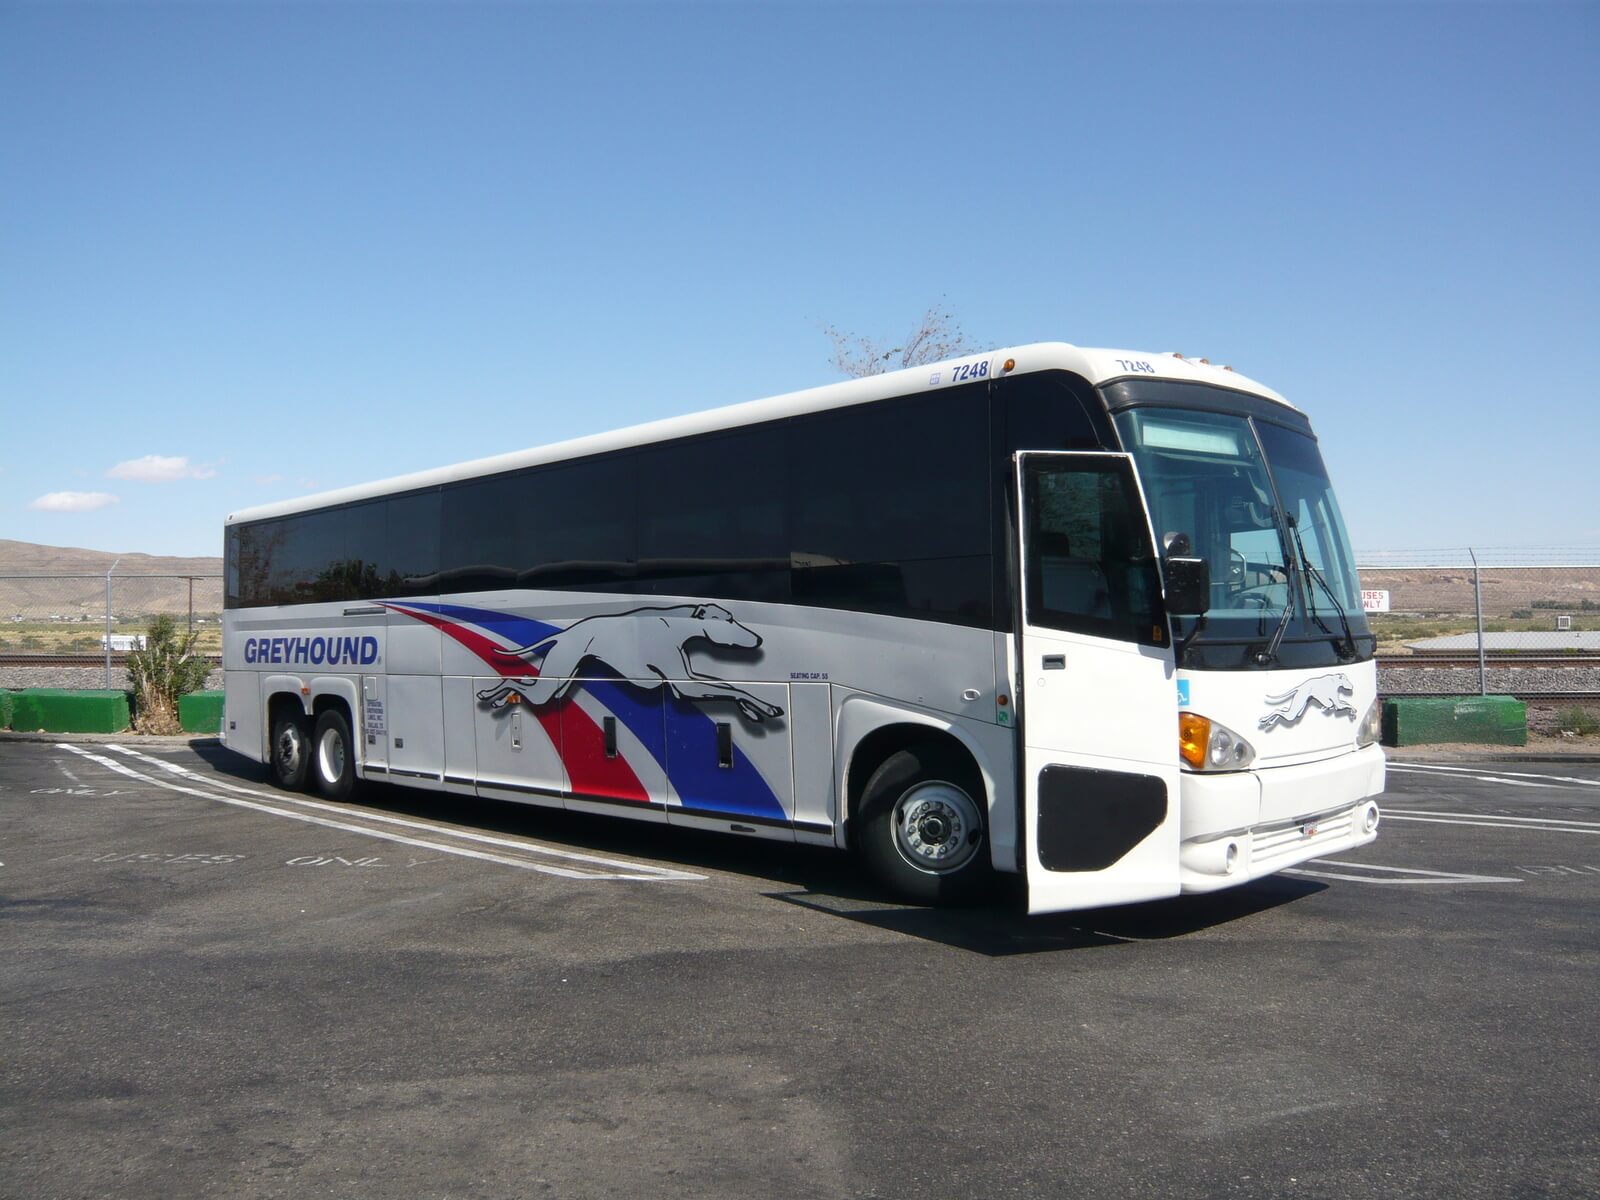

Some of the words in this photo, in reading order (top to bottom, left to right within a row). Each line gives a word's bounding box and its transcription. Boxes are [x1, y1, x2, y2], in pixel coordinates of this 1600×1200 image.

[952, 360, 989, 382] 7248
[1115, 359, 1155, 374] 7248
[1363, 600, 1381, 609] NLY
[244, 636, 378, 665] GREYHOUND
[285, 856, 446, 867] ONLY
